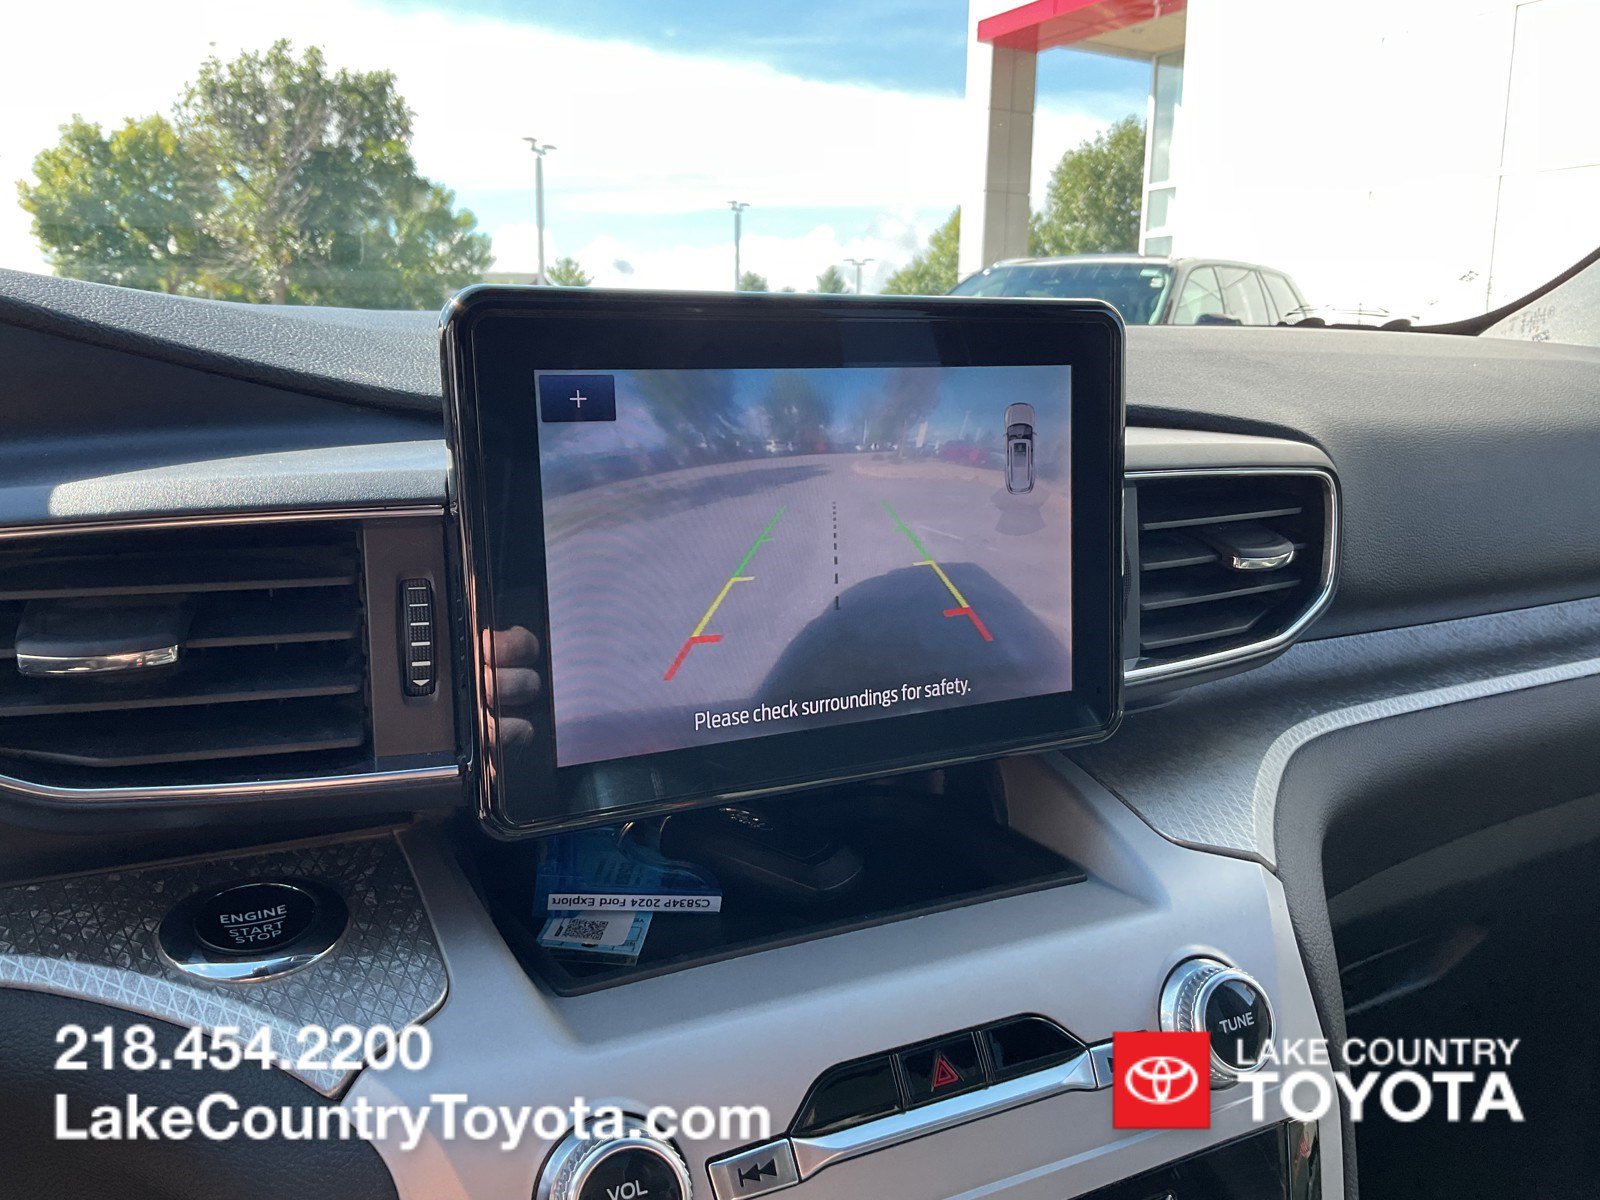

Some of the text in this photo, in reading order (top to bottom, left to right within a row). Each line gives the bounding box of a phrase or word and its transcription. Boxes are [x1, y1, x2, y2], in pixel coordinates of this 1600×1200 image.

[694, 678, 972, 730] Please check surroundings for safety.
[599, 897, 625, 908] Ford
[631, 898, 661, 908] 2024
[664, 897, 711, 908] C5834P
[219, 904, 287, 924] ENGINE
[229, 921, 284, 938] START
[235, 930, 282, 944] STOP
[1219, 1011, 1255, 1034] TUNE
[606, 1179, 649, 1200] VOL
